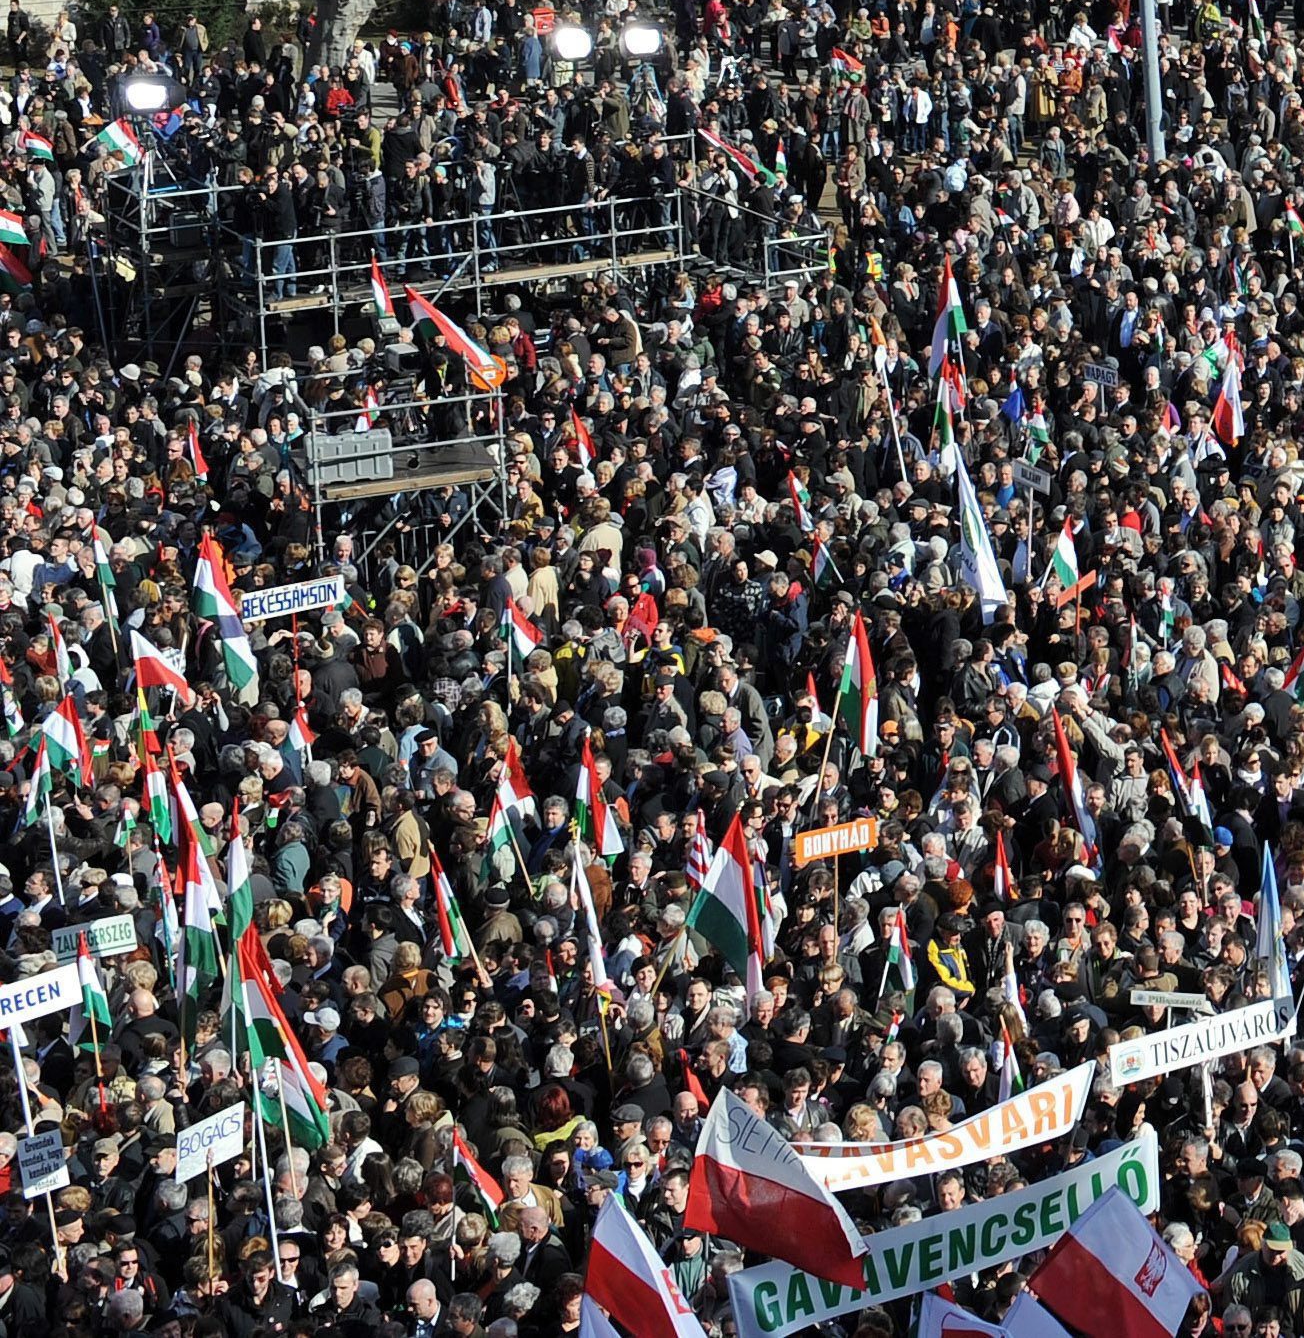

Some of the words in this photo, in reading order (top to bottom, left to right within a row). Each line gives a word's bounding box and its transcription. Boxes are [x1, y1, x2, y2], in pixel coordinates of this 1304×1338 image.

[803, 822, 870, 859] BONYHÁD
[55, 922, 132, 954] ZALGERSZEG
[1150, 1005, 1290, 1067] TISZAÚJVÁROS
[178, 1112, 242, 1162] BOGÁCS
